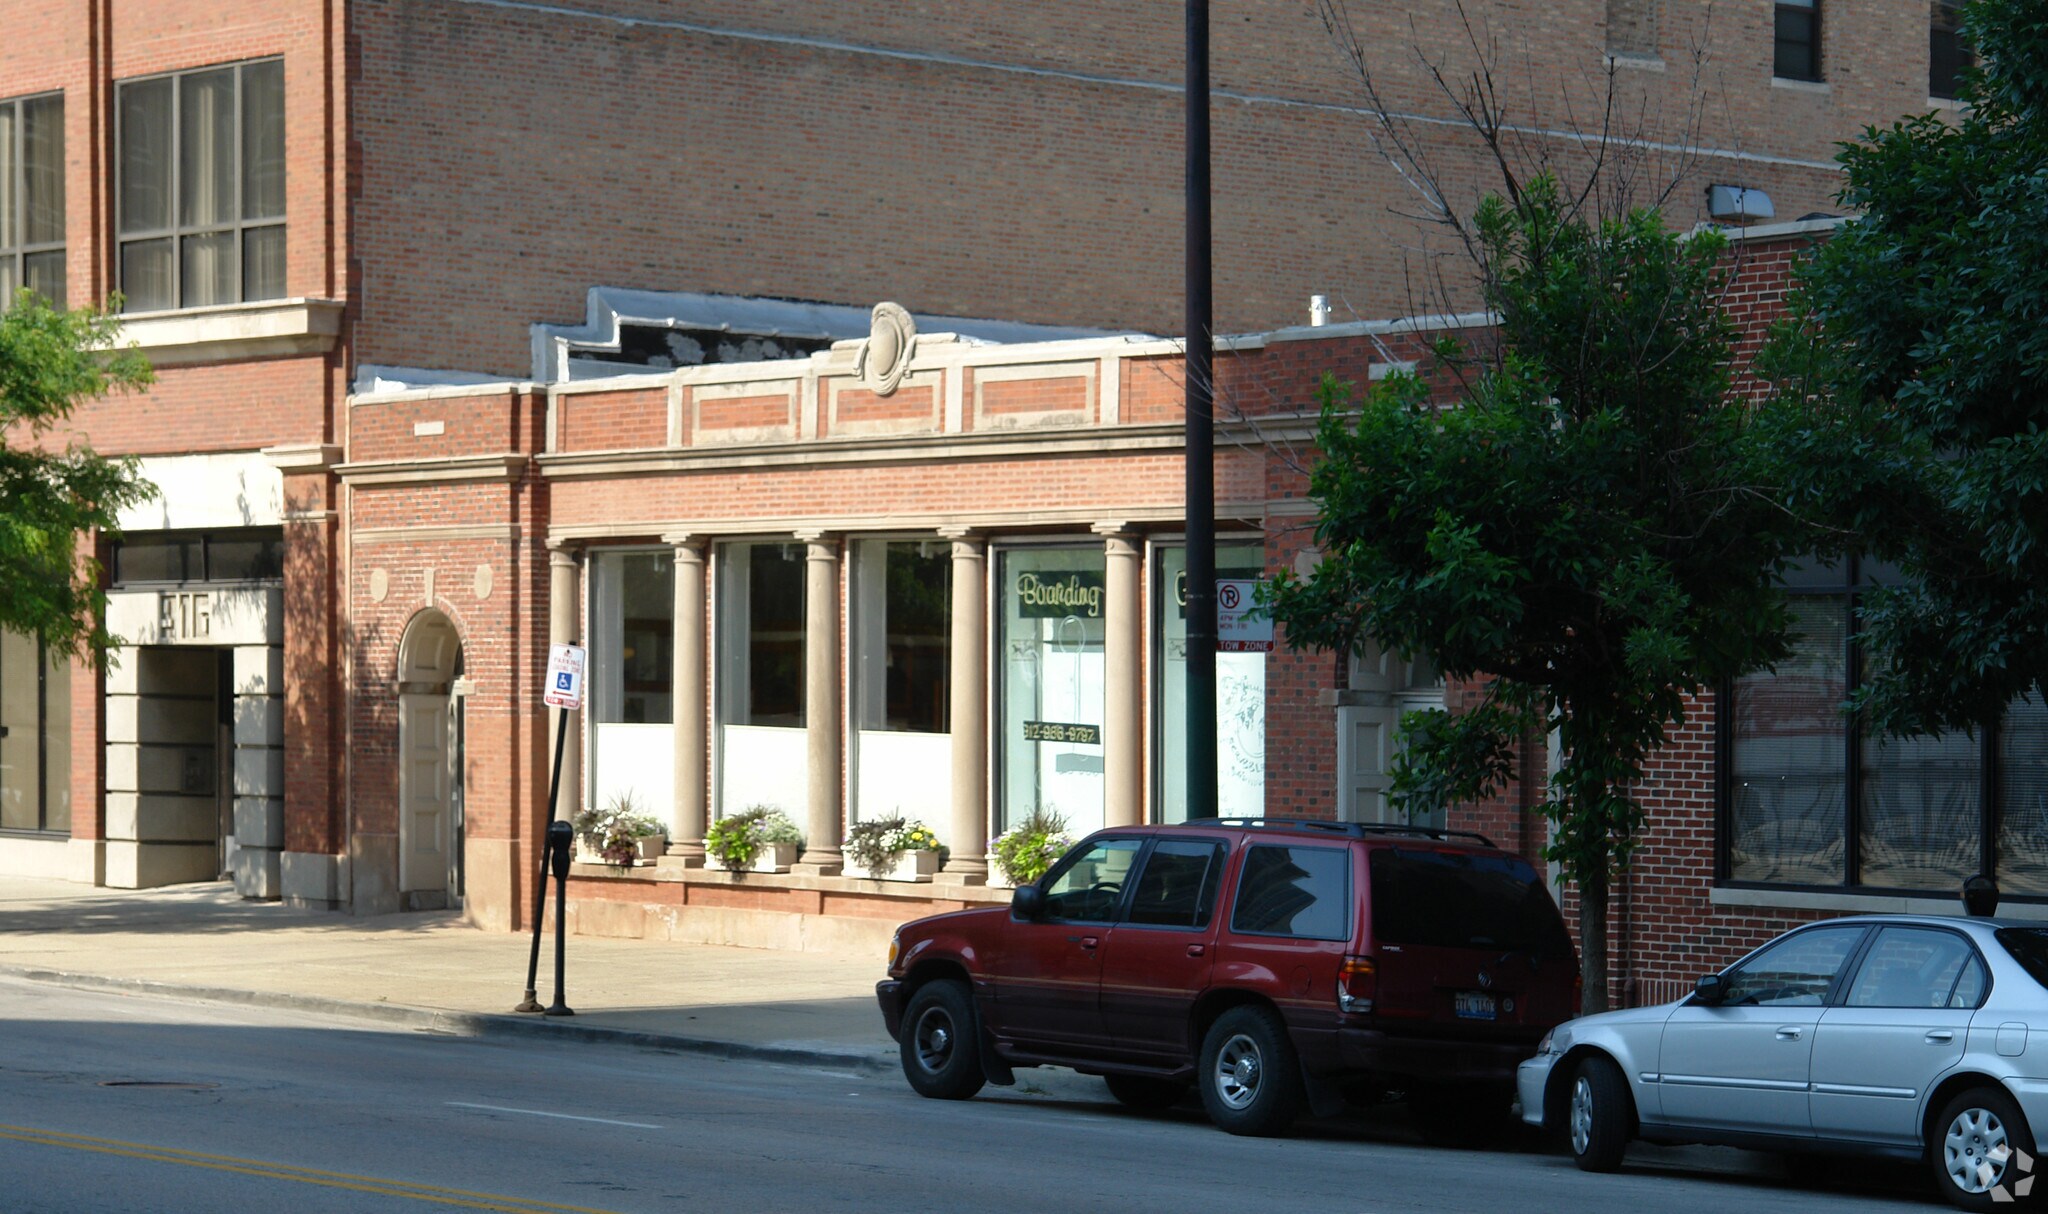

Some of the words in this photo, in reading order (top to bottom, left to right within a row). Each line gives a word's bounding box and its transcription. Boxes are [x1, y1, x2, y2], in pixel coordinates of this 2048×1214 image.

[1015, 573, 1104, 617] Boarding
[1220, 641, 1239, 650] TOW
[1244, 641, 1269, 651] ZONE
